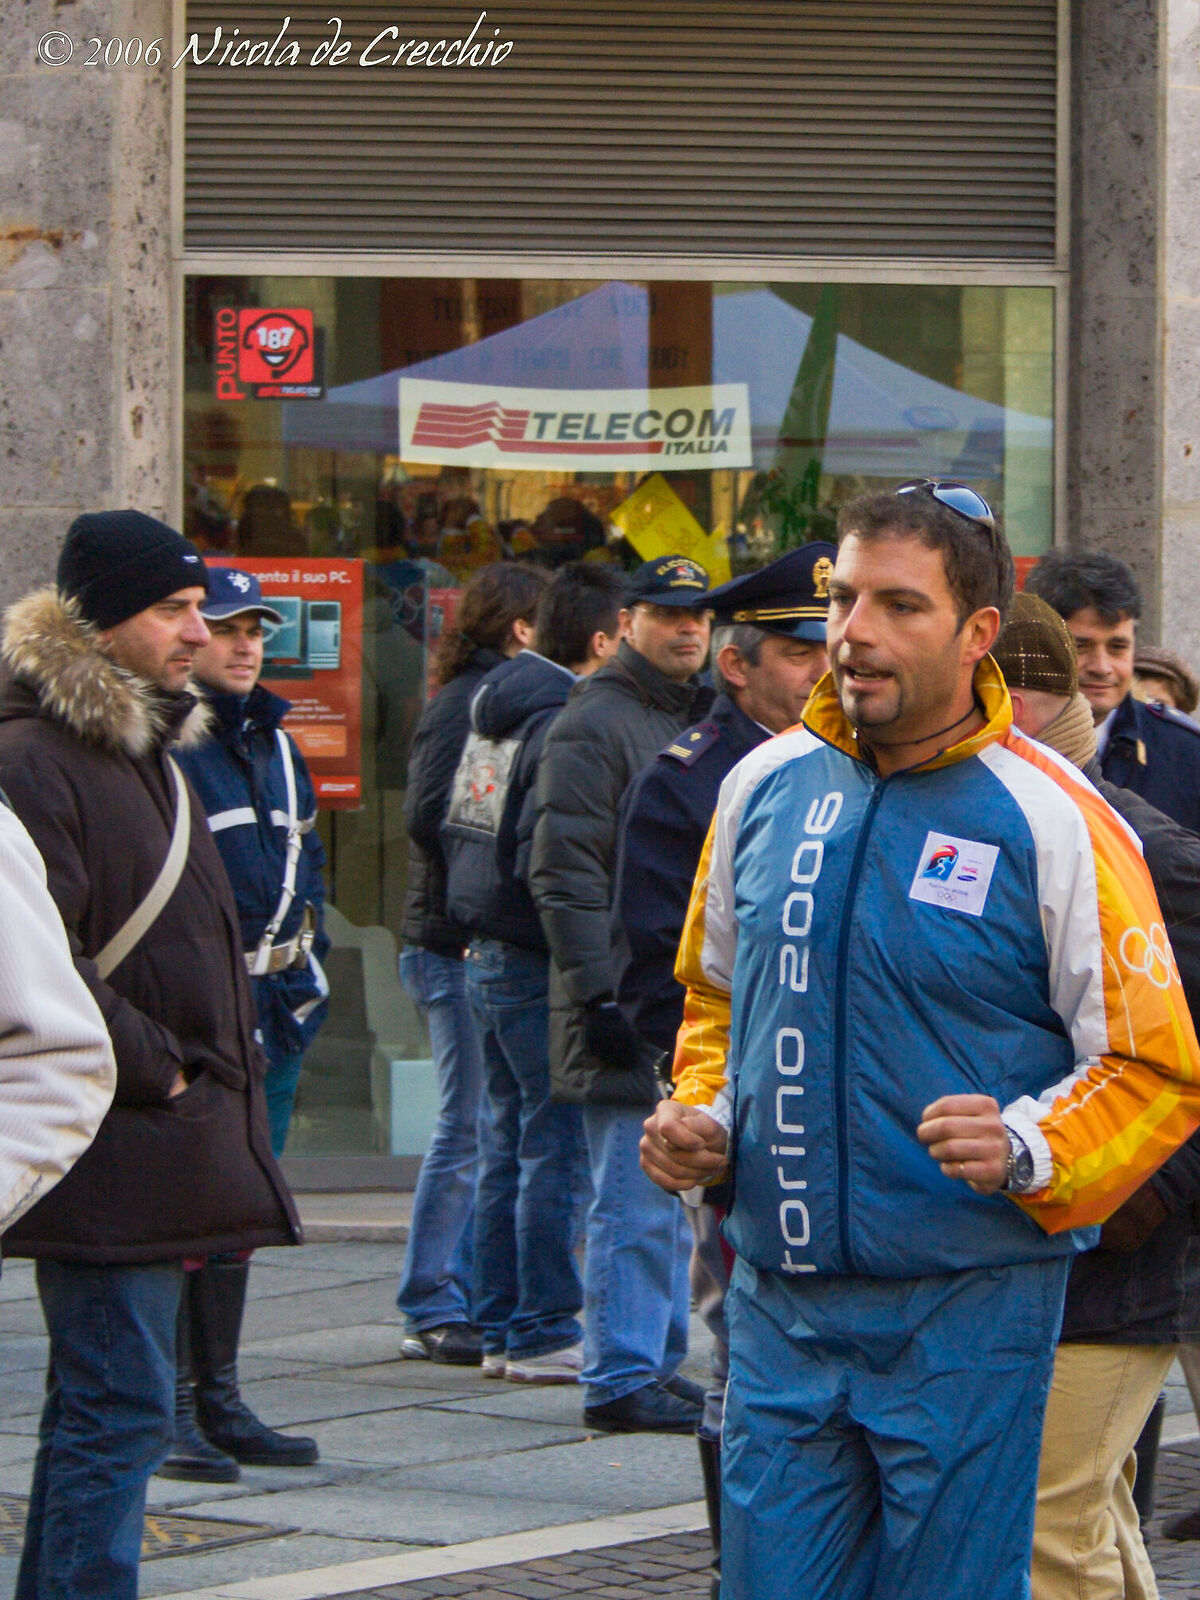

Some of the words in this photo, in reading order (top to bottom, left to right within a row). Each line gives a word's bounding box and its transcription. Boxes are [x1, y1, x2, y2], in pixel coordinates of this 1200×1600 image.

[217, 308, 245, 400] PUNTO
[256, 327, 295, 349] 187
[532, 408, 737, 441] TELECOM
[664, 440, 729, 456] ITALIA
[252, 572, 289, 583] ento
[302, 574, 326, 583] suo
[779, 791, 844, 993] 2006
[772, 1027, 816, 1274] torino
